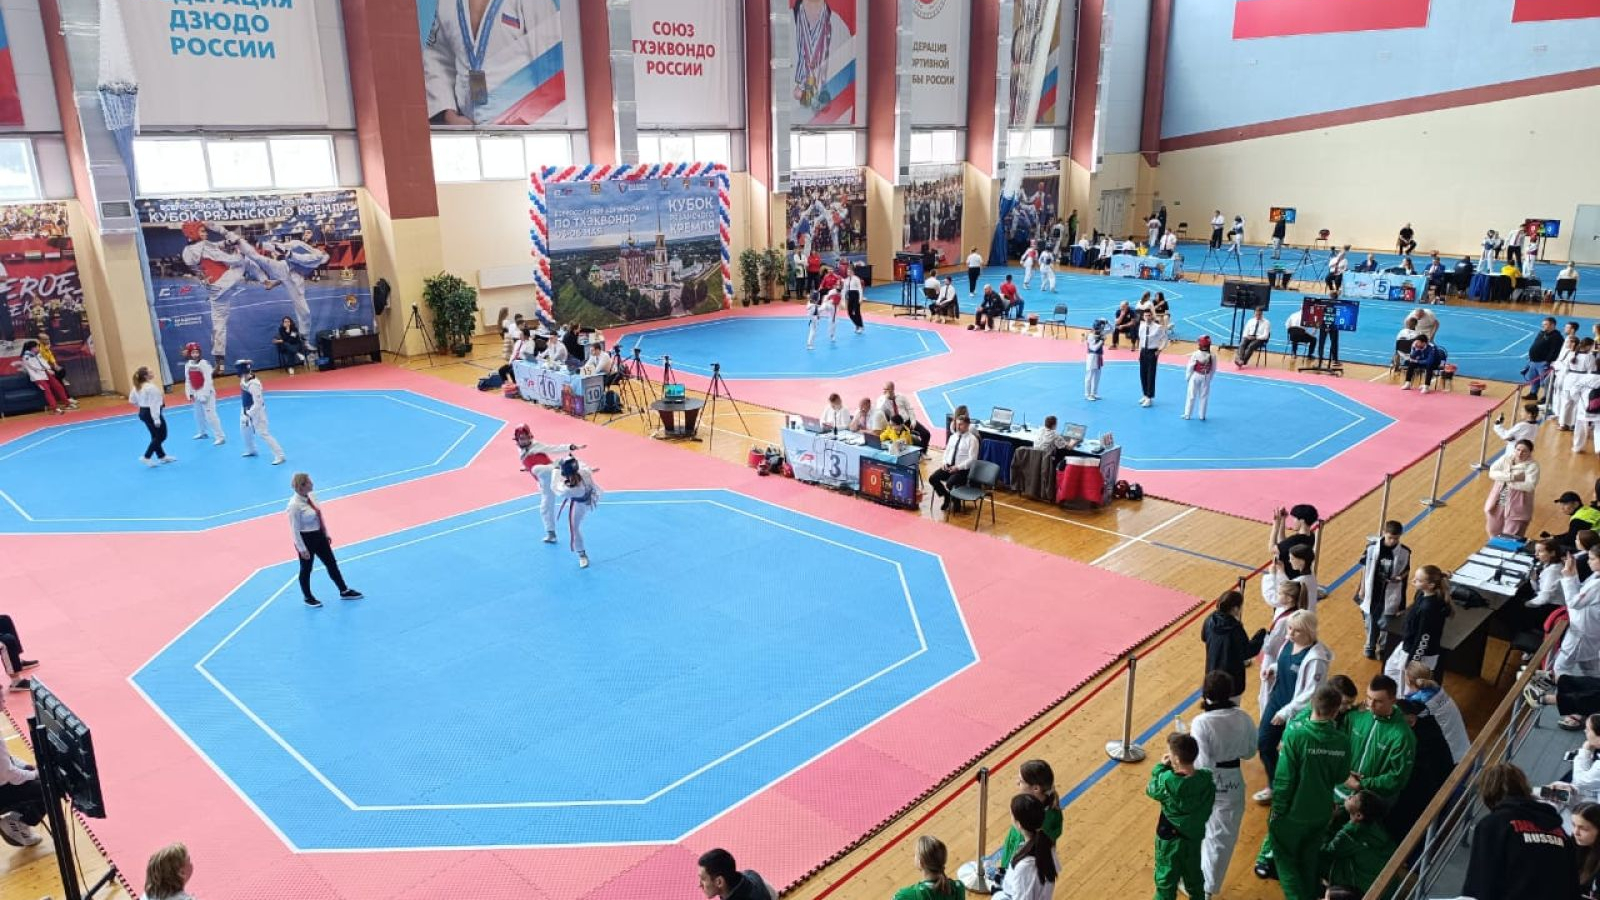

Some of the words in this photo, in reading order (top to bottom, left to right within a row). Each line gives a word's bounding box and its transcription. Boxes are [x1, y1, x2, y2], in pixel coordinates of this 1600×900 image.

[169, 10, 270, 35] ДЗЮДО
[652, 21, 695, 37] СОЮЗ
[170, 36, 276, 59] РОССИИ
[646, 60, 703, 76] РОССИИ
[926, 75, 955, 85] РОССИИ
[669, 196, 713, 212] КУБОК
[148, 210, 201, 223] КУБОК
[203, 206, 294, 221] РЯЗАНСКОГО
[298, 203, 349, 216] КРЕМЛЯ
[573, 213, 637, 227] ТХЭКВОНДО
[670, 219, 715, 236] КРЕМЛЯ
[1378, 280, 1387, 293] 5
[540, 379, 556, 399] 10
[588, 388, 600, 399] 10
[829, 454, 842, 478] 3
[870, 474, 878, 486] 0
[895, 480, 903, 492] 0
